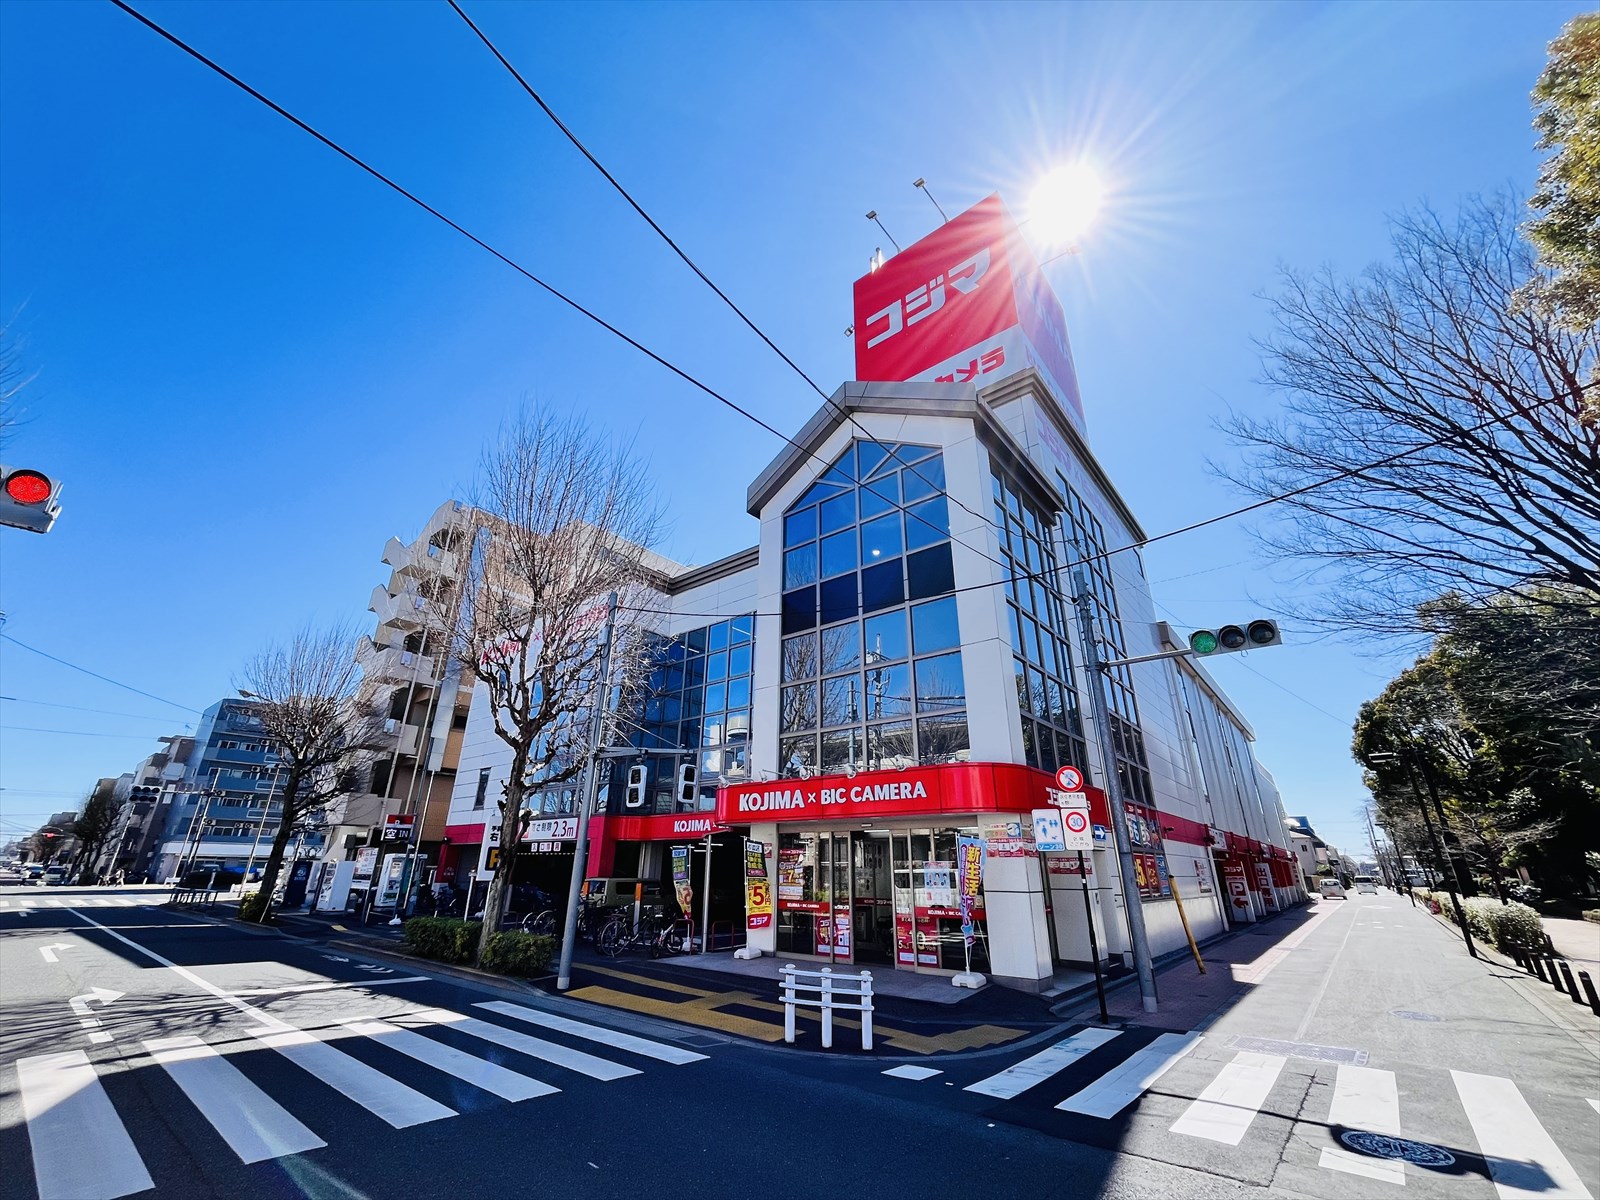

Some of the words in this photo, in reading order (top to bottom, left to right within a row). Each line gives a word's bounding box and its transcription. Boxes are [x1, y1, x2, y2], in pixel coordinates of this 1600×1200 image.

[866, 247, 991, 349] コジマ
[739, 789, 805, 812] KOJIMA
[820, 788, 847, 805] BIC
[850, 781, 927, 801] CAMERA
[551, 820, 574, 838] 2.3m
[674, 819, 711, 833] KOJIMA
[1070, 817, 1083, 827] 30
[385, 829, 398, 839] 空
[398, 830, 409, 838] IN
[965, 846, 981, 897] 新生活
[752, 885, 765, 906] 5
[1231, 882, 1243, 896] P
